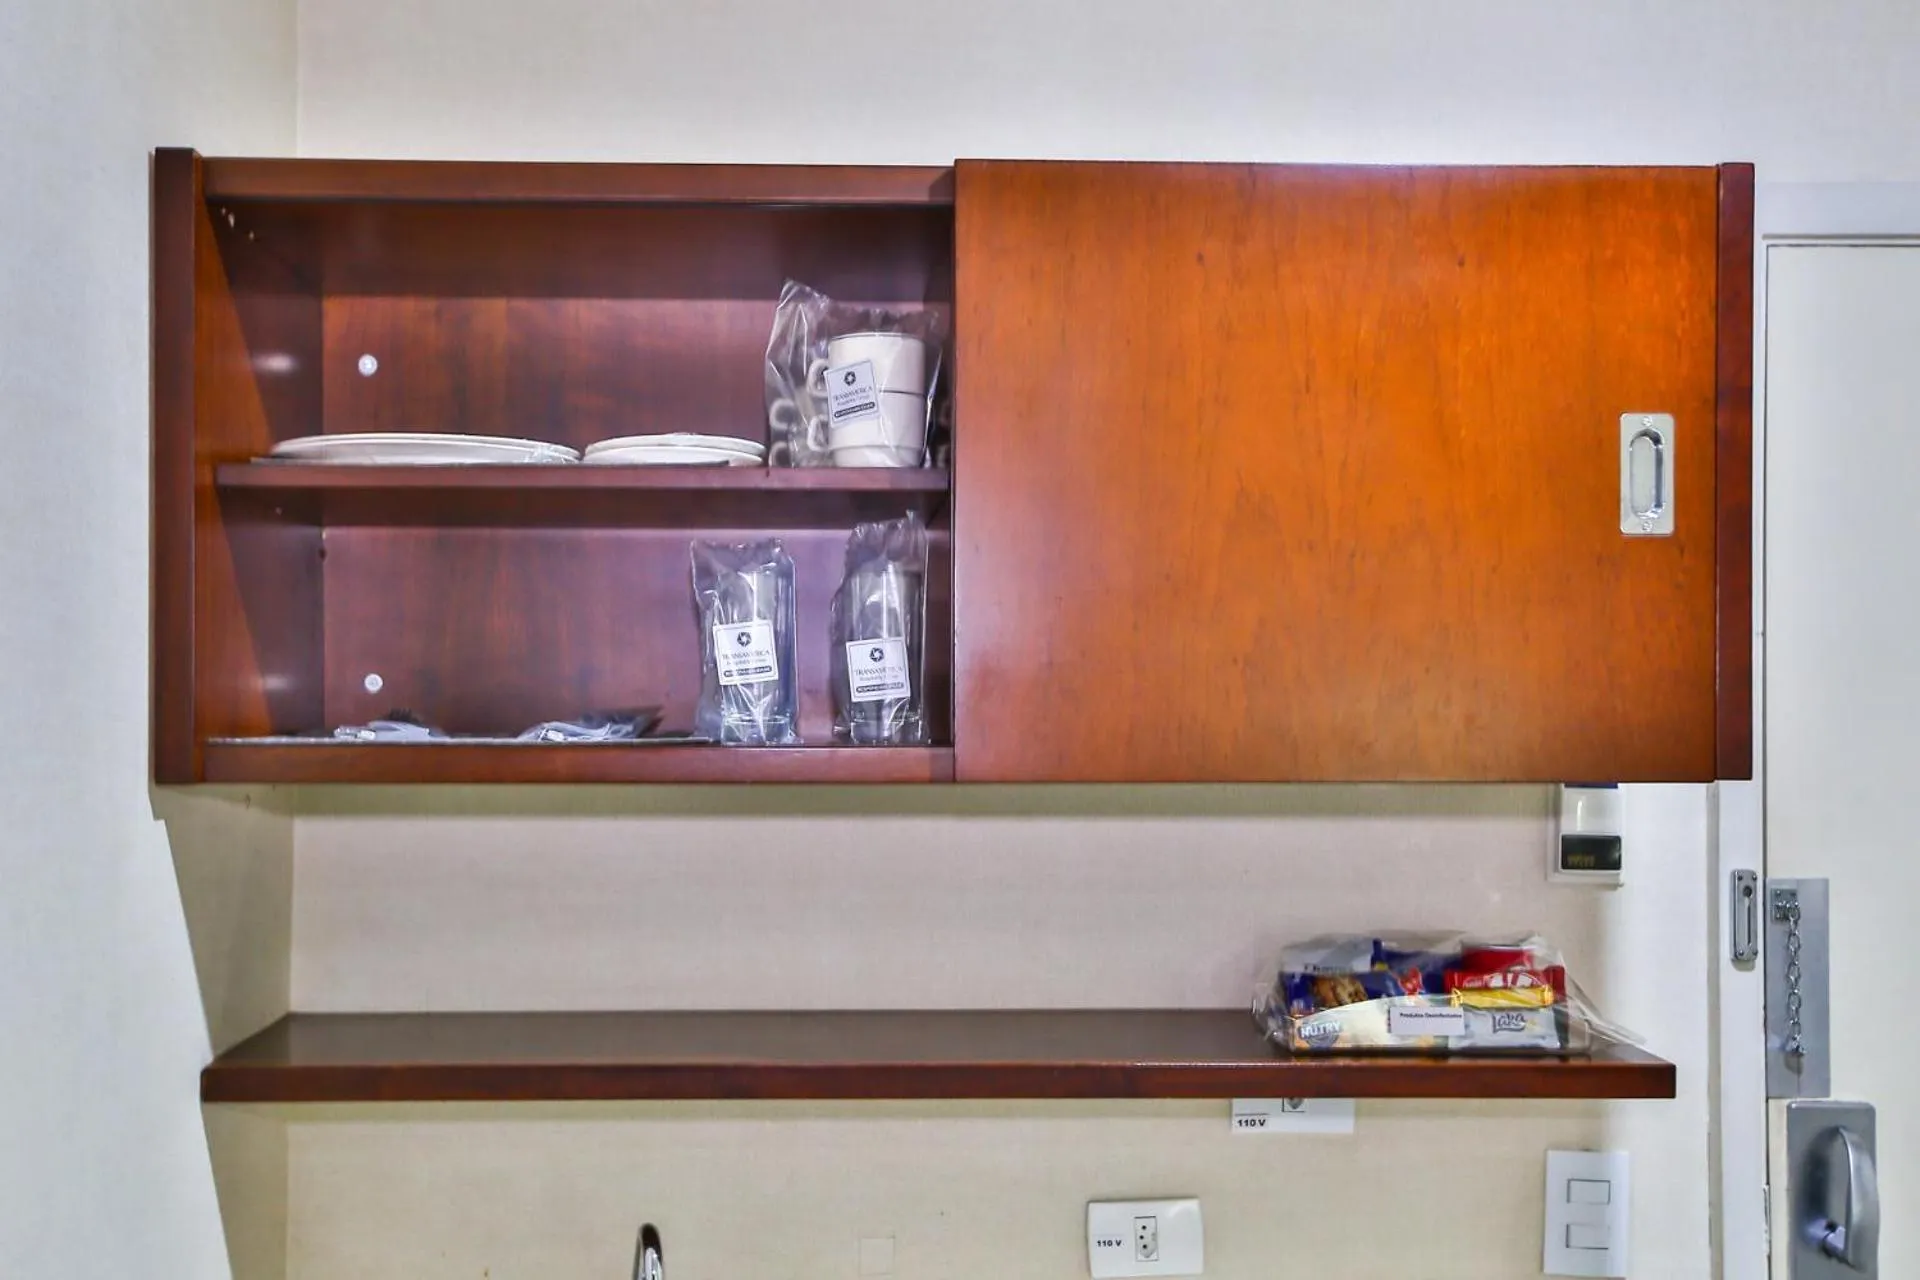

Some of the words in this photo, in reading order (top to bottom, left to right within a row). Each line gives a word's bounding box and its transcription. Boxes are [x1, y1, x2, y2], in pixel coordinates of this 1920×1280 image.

[1300, 1020, 1341, 1039] NUTRY
[1237, 1119, 1256, 1127] 110
[1257, 1119, 1266, 1127] V
[1097, 1239, 1113, 1247] 110
[1115, 1239, 1122, 1247] V
